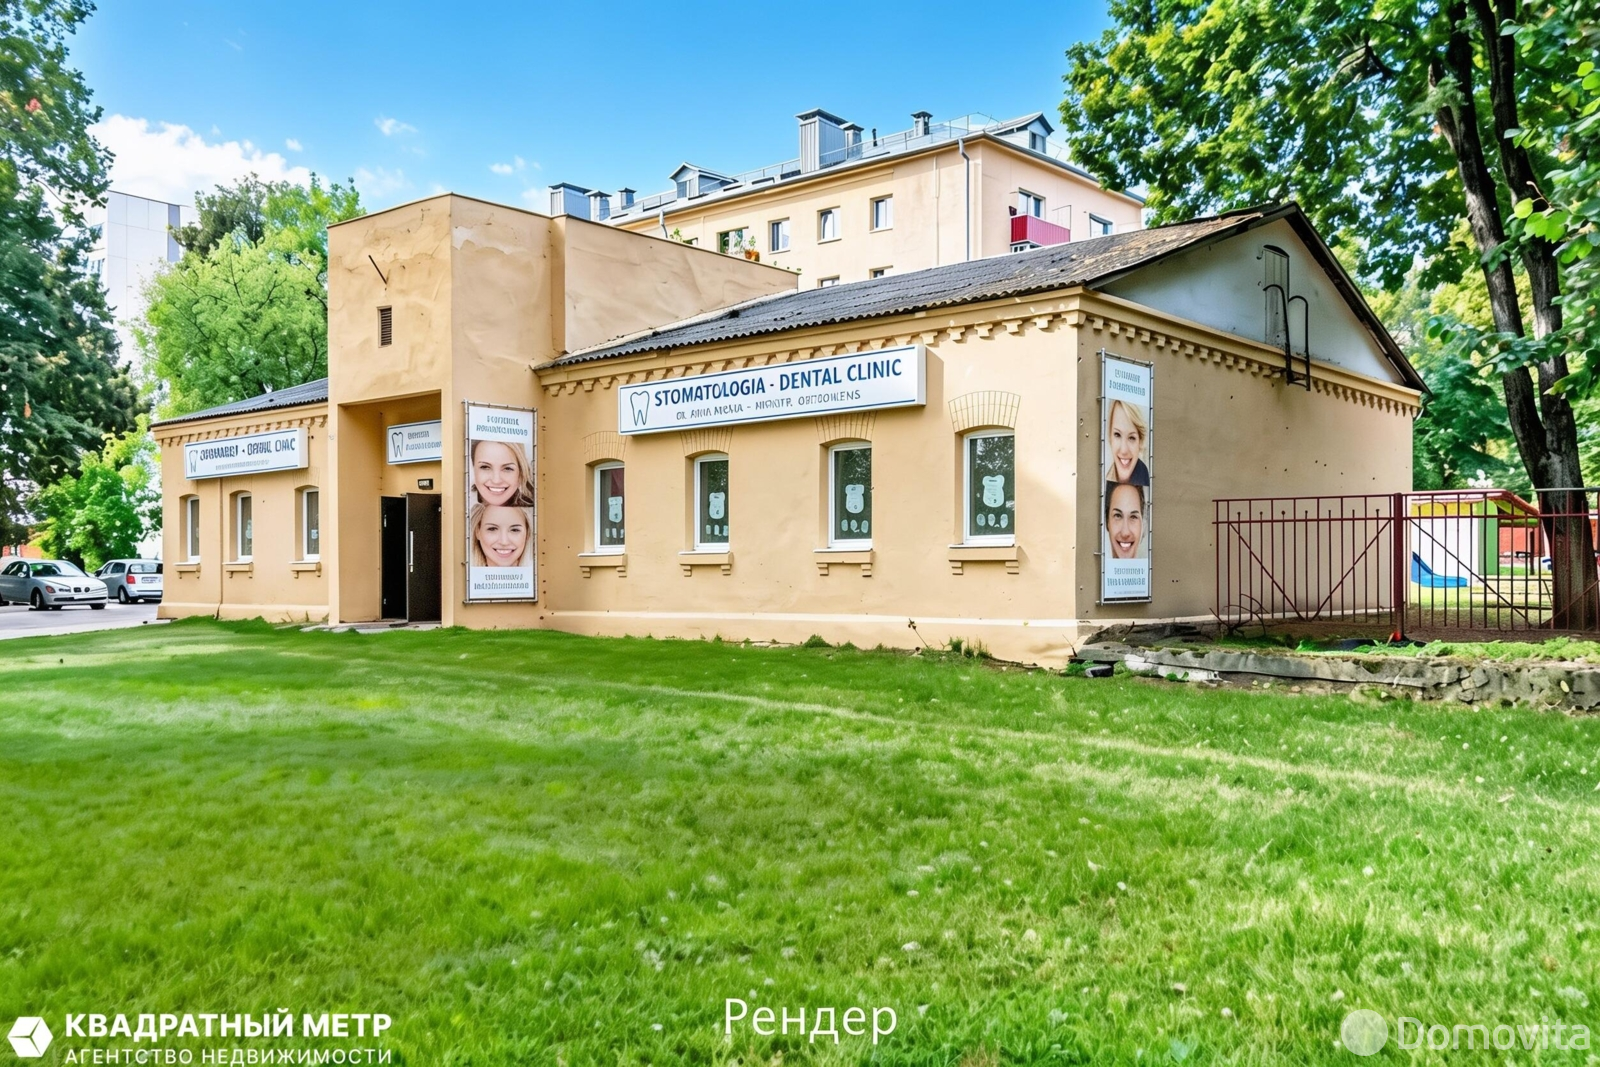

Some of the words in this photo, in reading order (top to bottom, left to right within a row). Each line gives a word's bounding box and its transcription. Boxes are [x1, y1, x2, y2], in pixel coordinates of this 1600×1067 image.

[655, 377, 766, 406] STOMATOLOGIA
[780, 367, 842, 391] DENTAL
[847, 358, 902, 381] CLINIC
